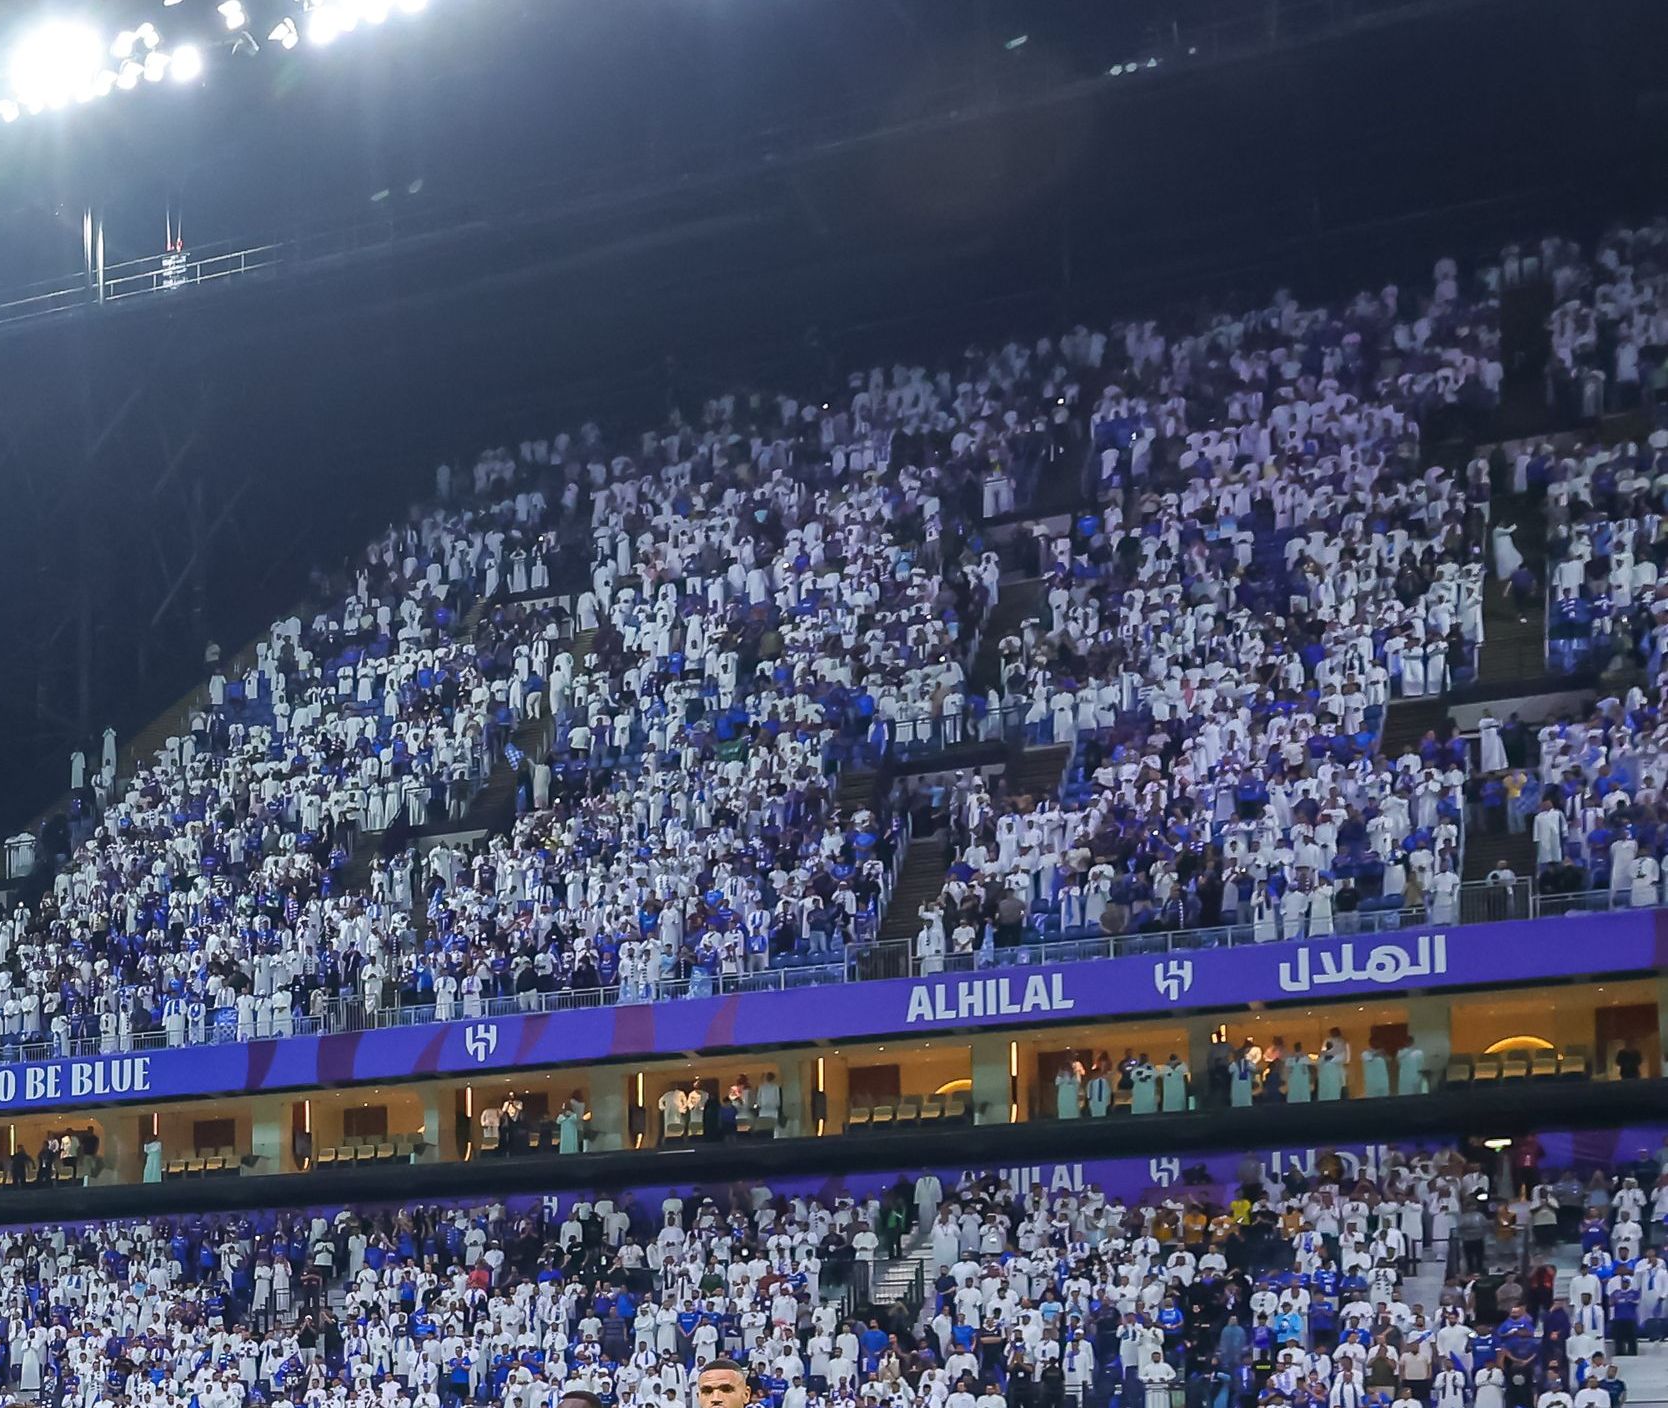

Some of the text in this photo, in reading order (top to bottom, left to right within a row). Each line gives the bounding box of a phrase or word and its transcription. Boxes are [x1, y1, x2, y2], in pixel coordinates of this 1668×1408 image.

[1279, 934, 1448, 992] الهلال
[906, 972, 1075, 1023] ALHILAL
[25, 1065, 62, 1100] BE
[71, 1057, 151, 1097] BLUE
